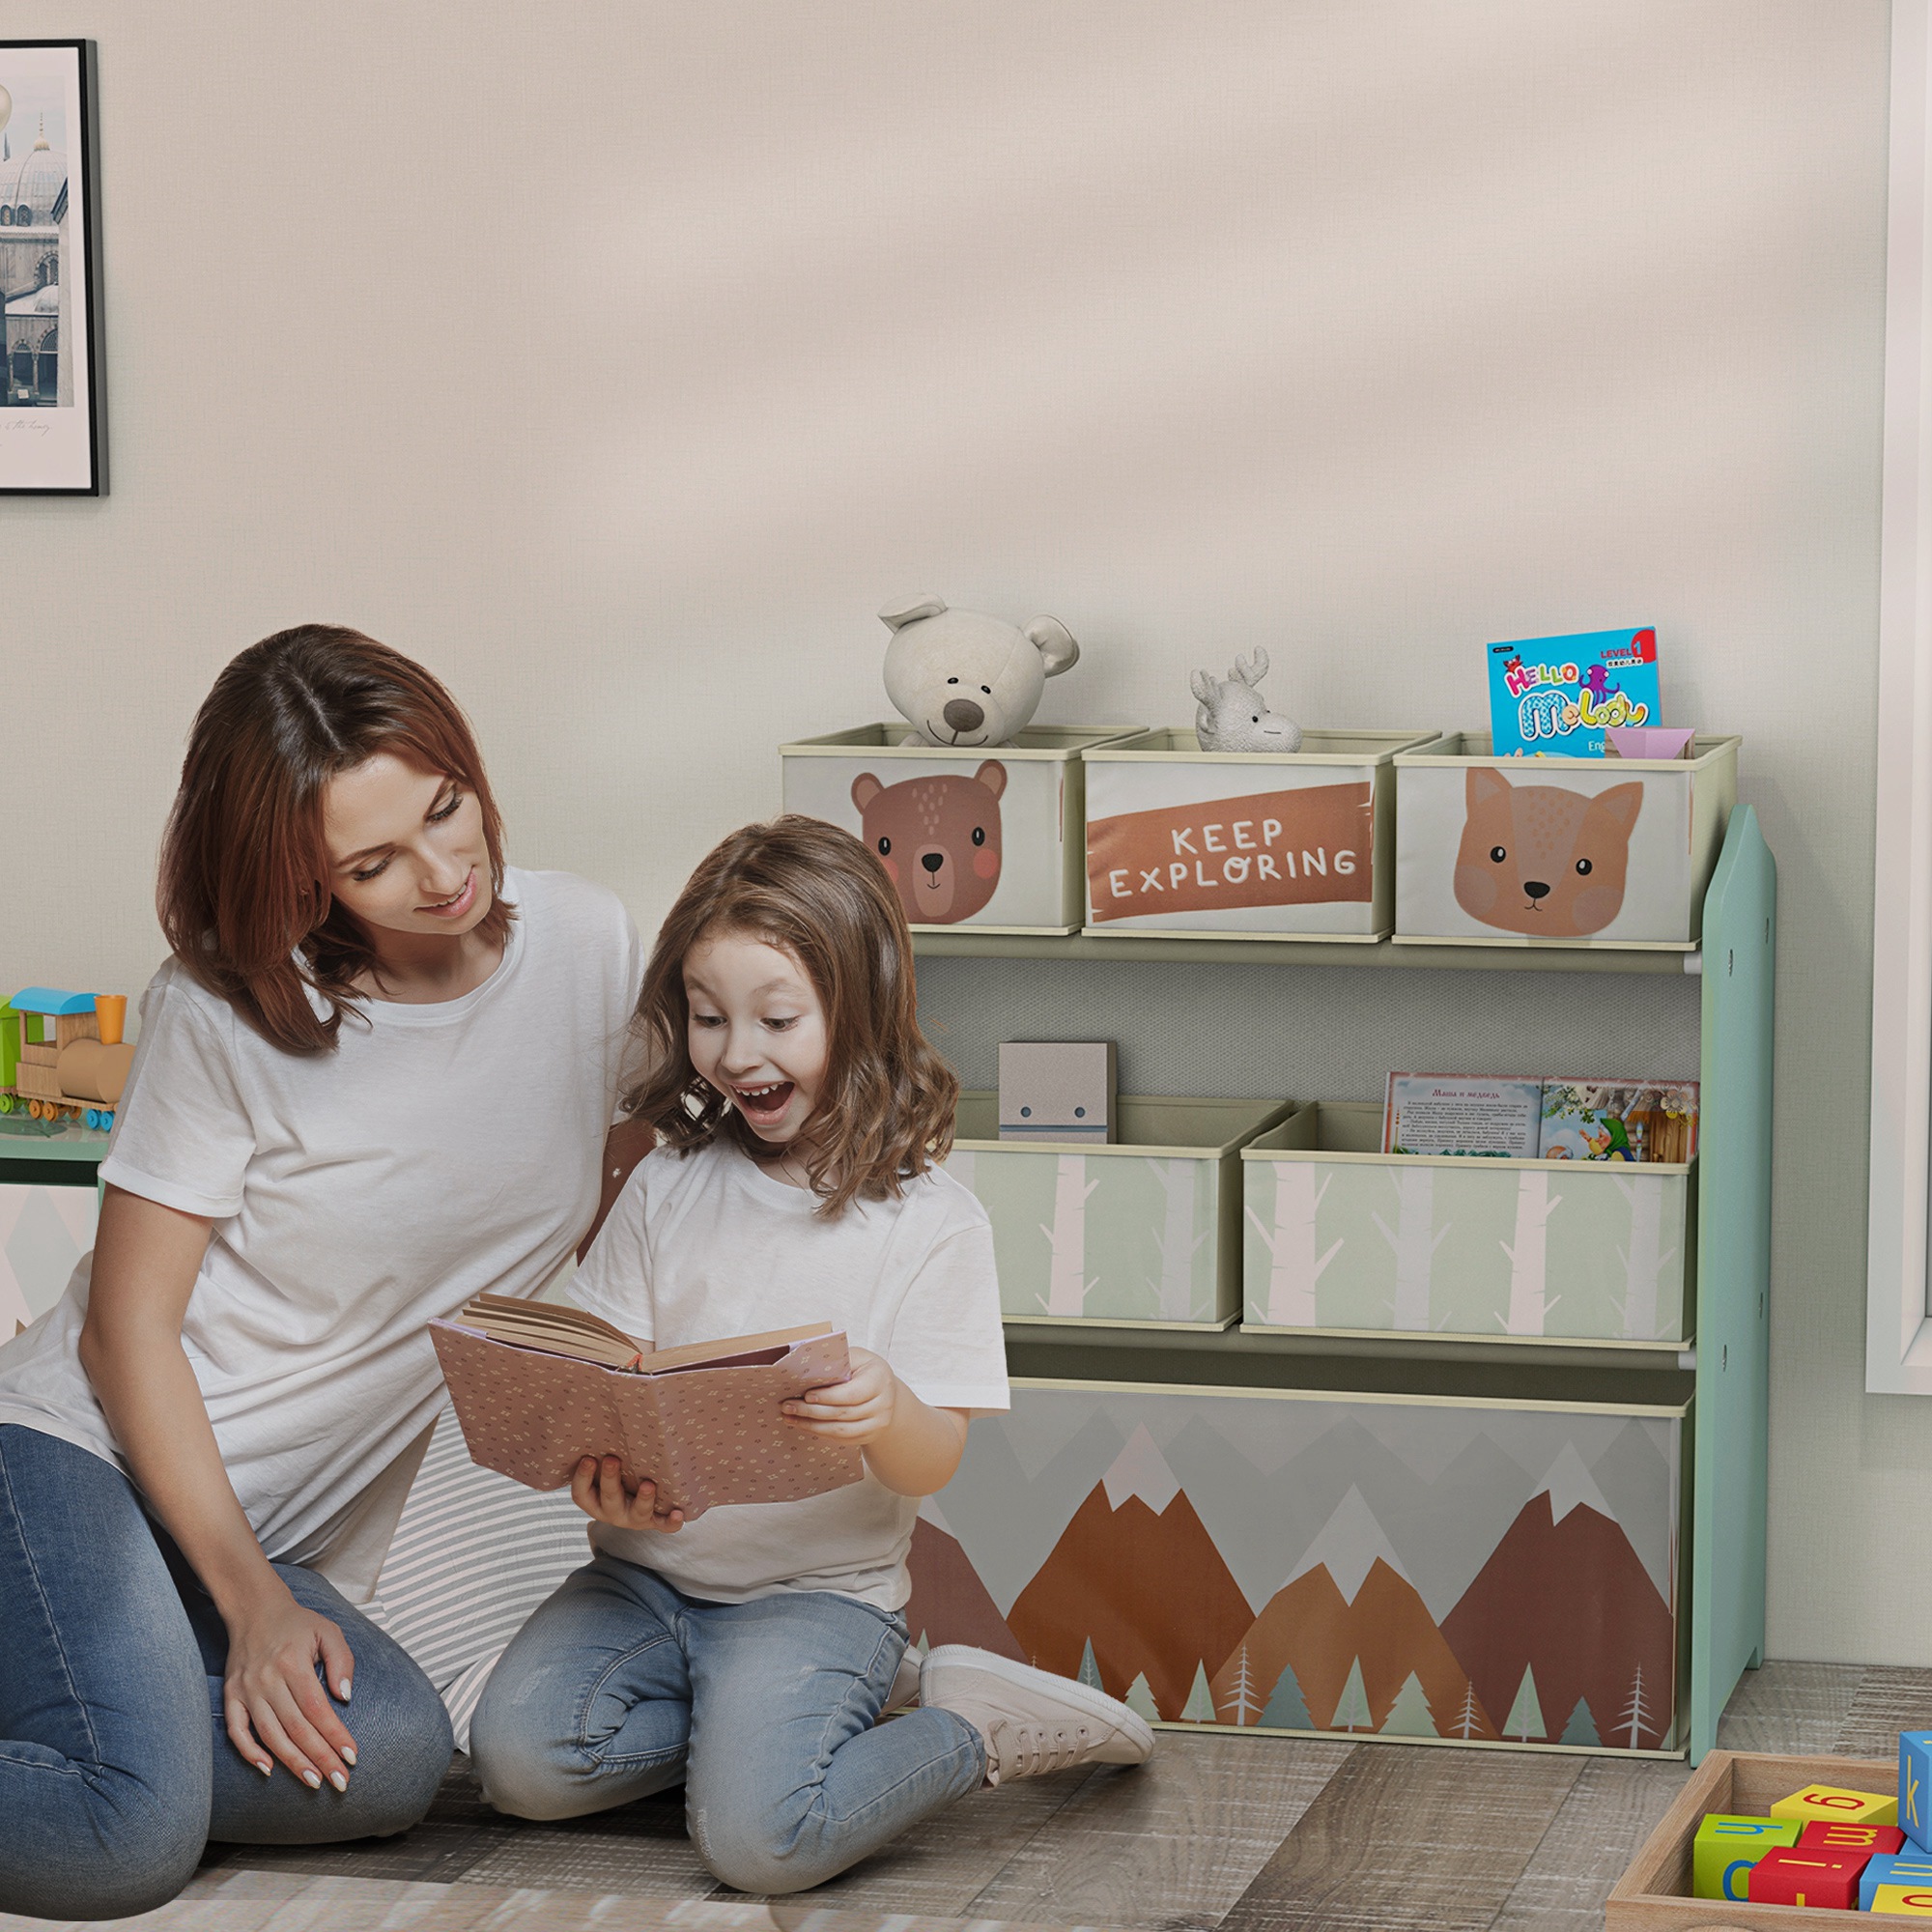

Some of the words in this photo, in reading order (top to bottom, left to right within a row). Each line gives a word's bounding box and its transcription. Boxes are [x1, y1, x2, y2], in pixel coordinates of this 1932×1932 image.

[1600, 648, 1632, 659] LEVEL
[1633, 640, 1642, 657] 1
[1505, 663, 1578, 696] HELLO
[1171, 818, 1283, 856] KEEP
[1109, 847, 1356, 898] EXPLORING
[1906, 1754, 1919, 1829] k
[1715, 1822, 1783, 1835] h
[1823, 1826, 1878, 1846] m
